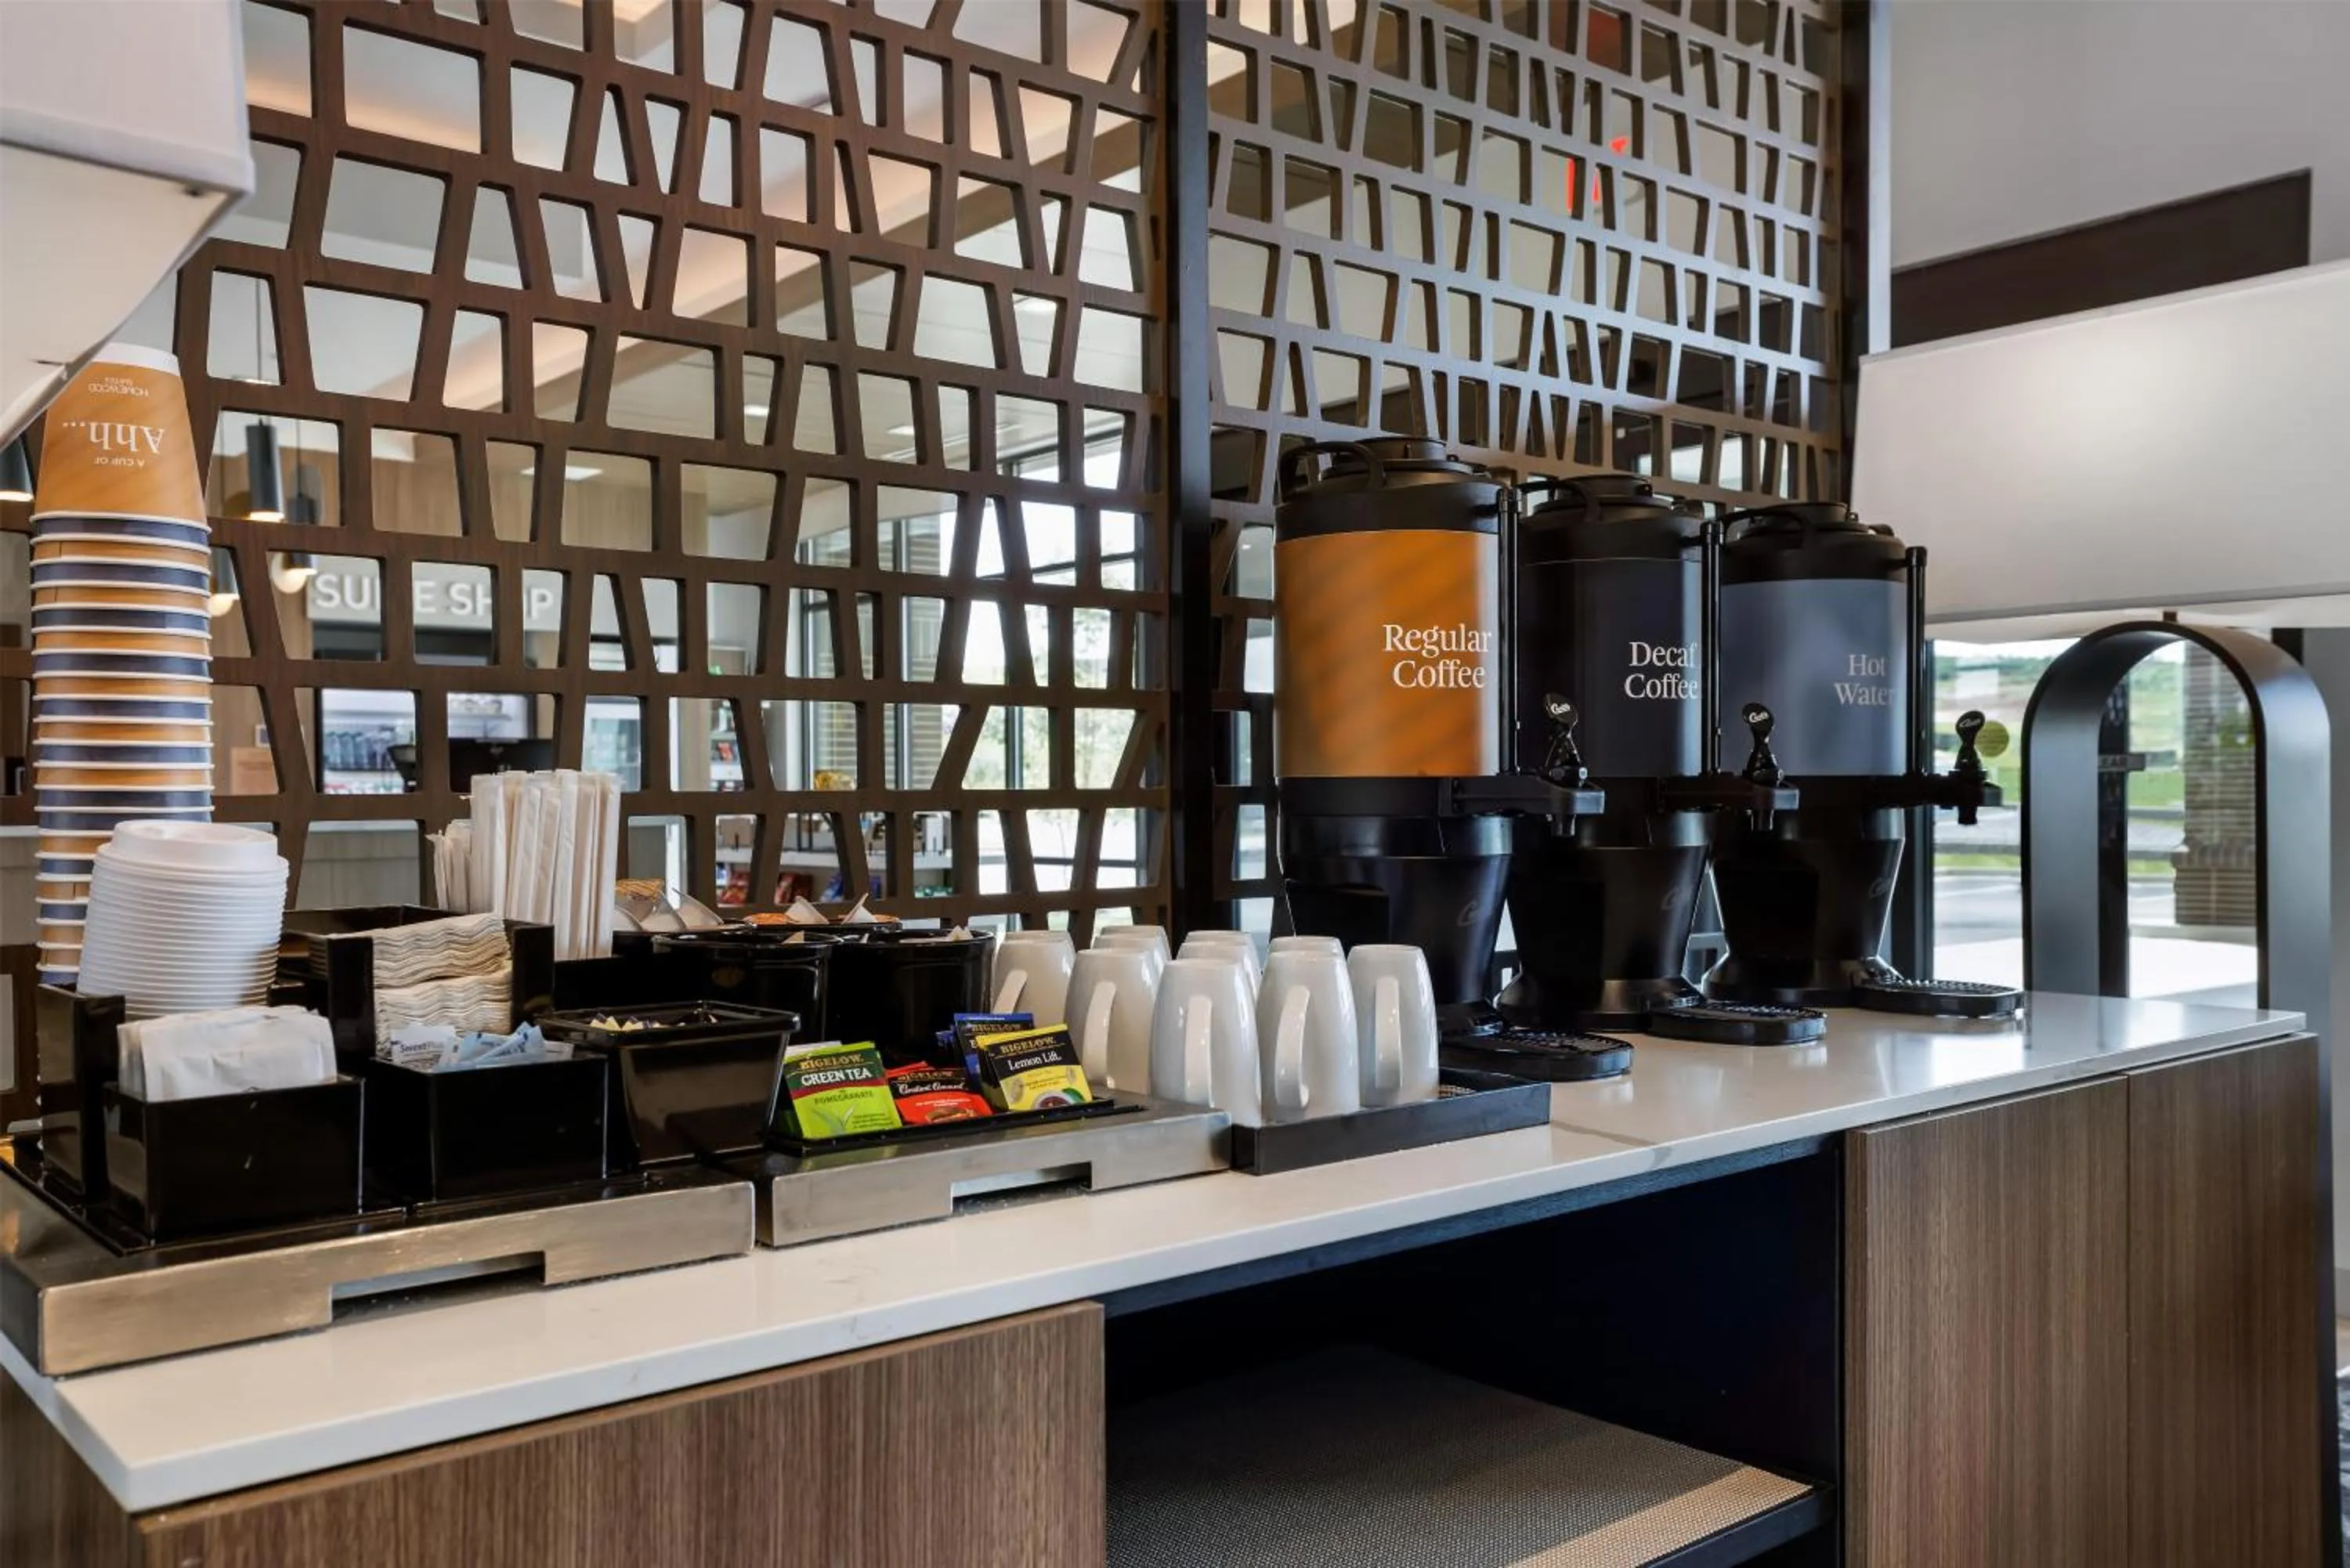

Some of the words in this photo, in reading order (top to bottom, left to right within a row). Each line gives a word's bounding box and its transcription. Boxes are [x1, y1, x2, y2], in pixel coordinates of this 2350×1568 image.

[111, 457, 134, 467] CUP
[315, 573, 437, 614] SUIE
[449, 583, 554, 620] SHP
[1382, 623, 1492, 659] Regular
[1629, 641, 1698, 668] Decaf
[1848, 653, 1886, 677] Hot
[1393, 659, 1488, 688] Coffee
[1624, 673, 1699, 699] Coffee
[1834, 681, 1896, 706] Water
[800, 1053, 863, 1069] BIGELOW
[1007, 1057, 1043, 1071] Lemon
[801, 1069, 844, 1086] GREEN
[846, 1068, 873, 1079] TEA
